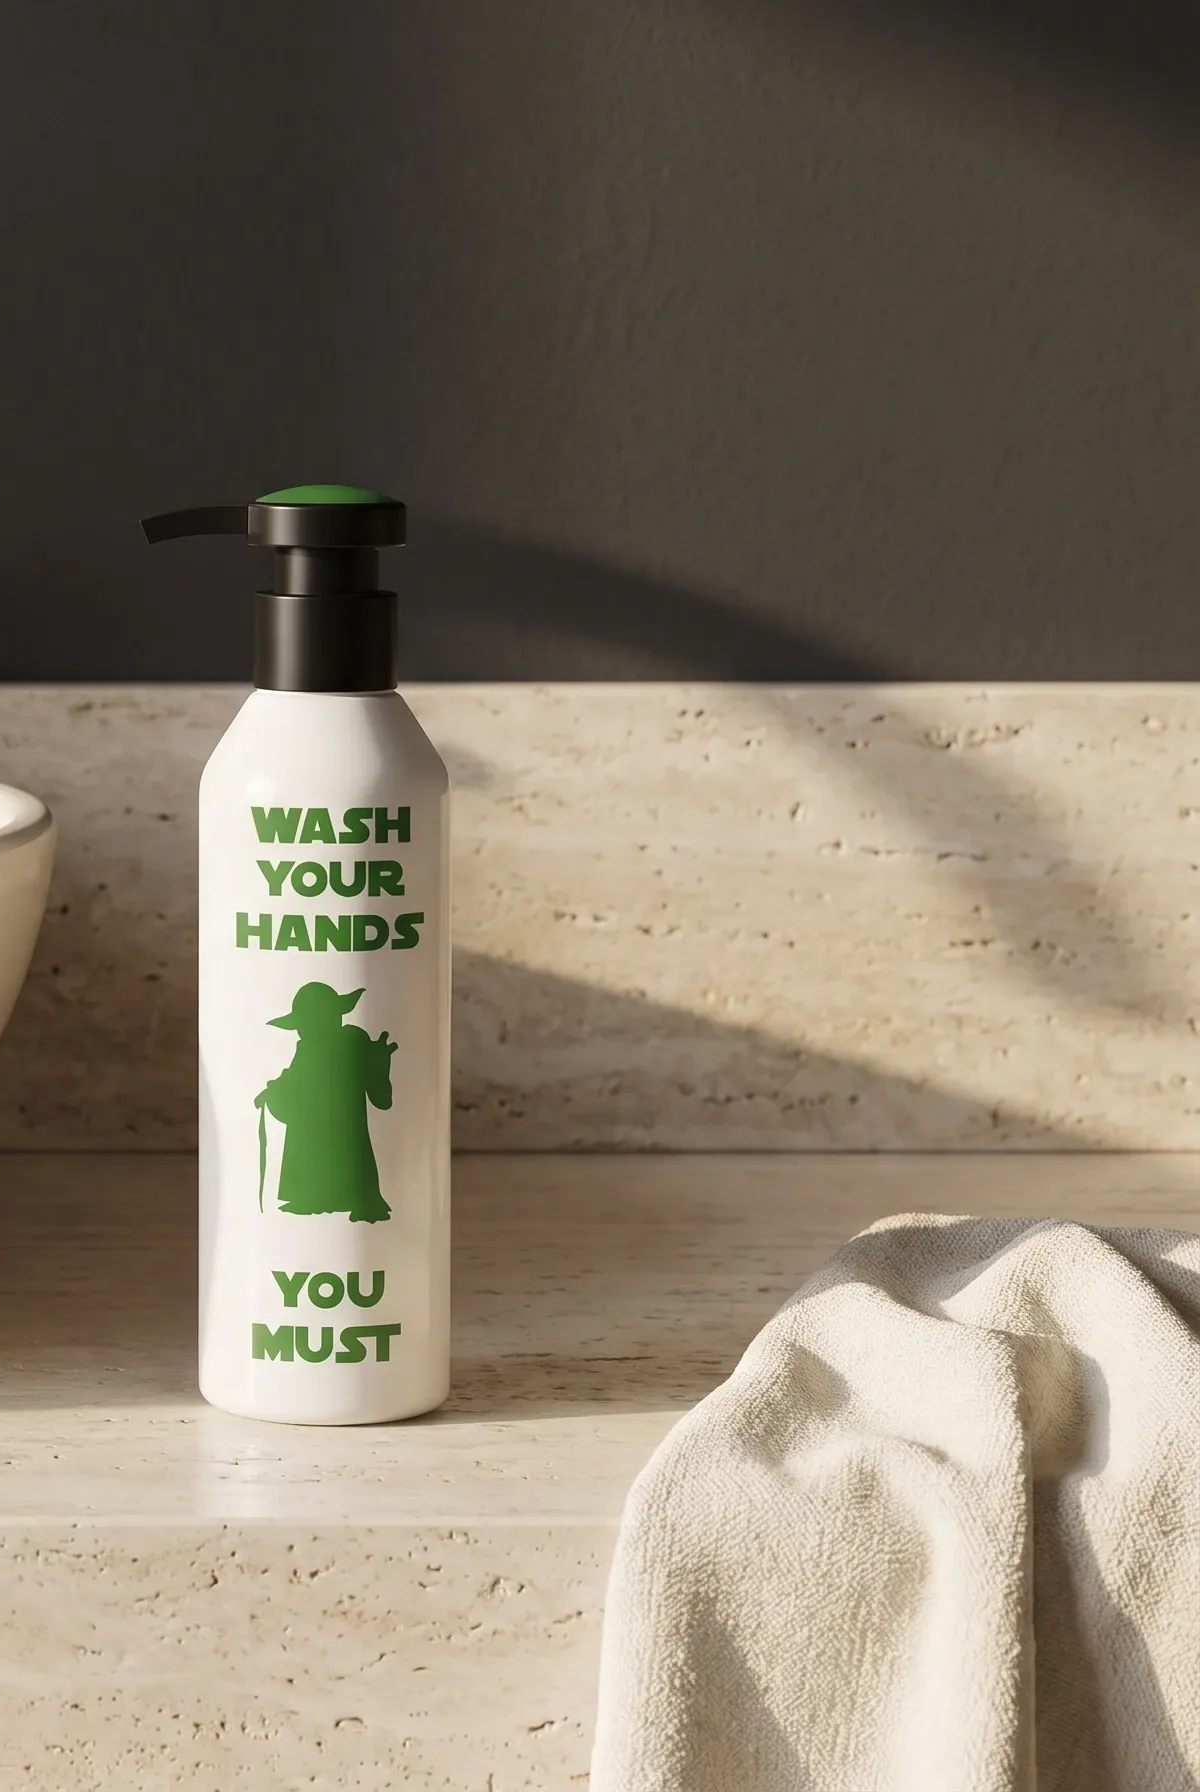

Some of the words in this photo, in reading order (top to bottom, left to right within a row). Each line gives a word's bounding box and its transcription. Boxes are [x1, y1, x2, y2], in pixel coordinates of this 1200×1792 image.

[251, 806, 411, 844] WASH
[256, 860, 405, 897] YOUR
[236, 912, 425, 952] HANDS
[271, 1270, 385, 1309] YOU
[252, 1323, 401, 1363] MUST
